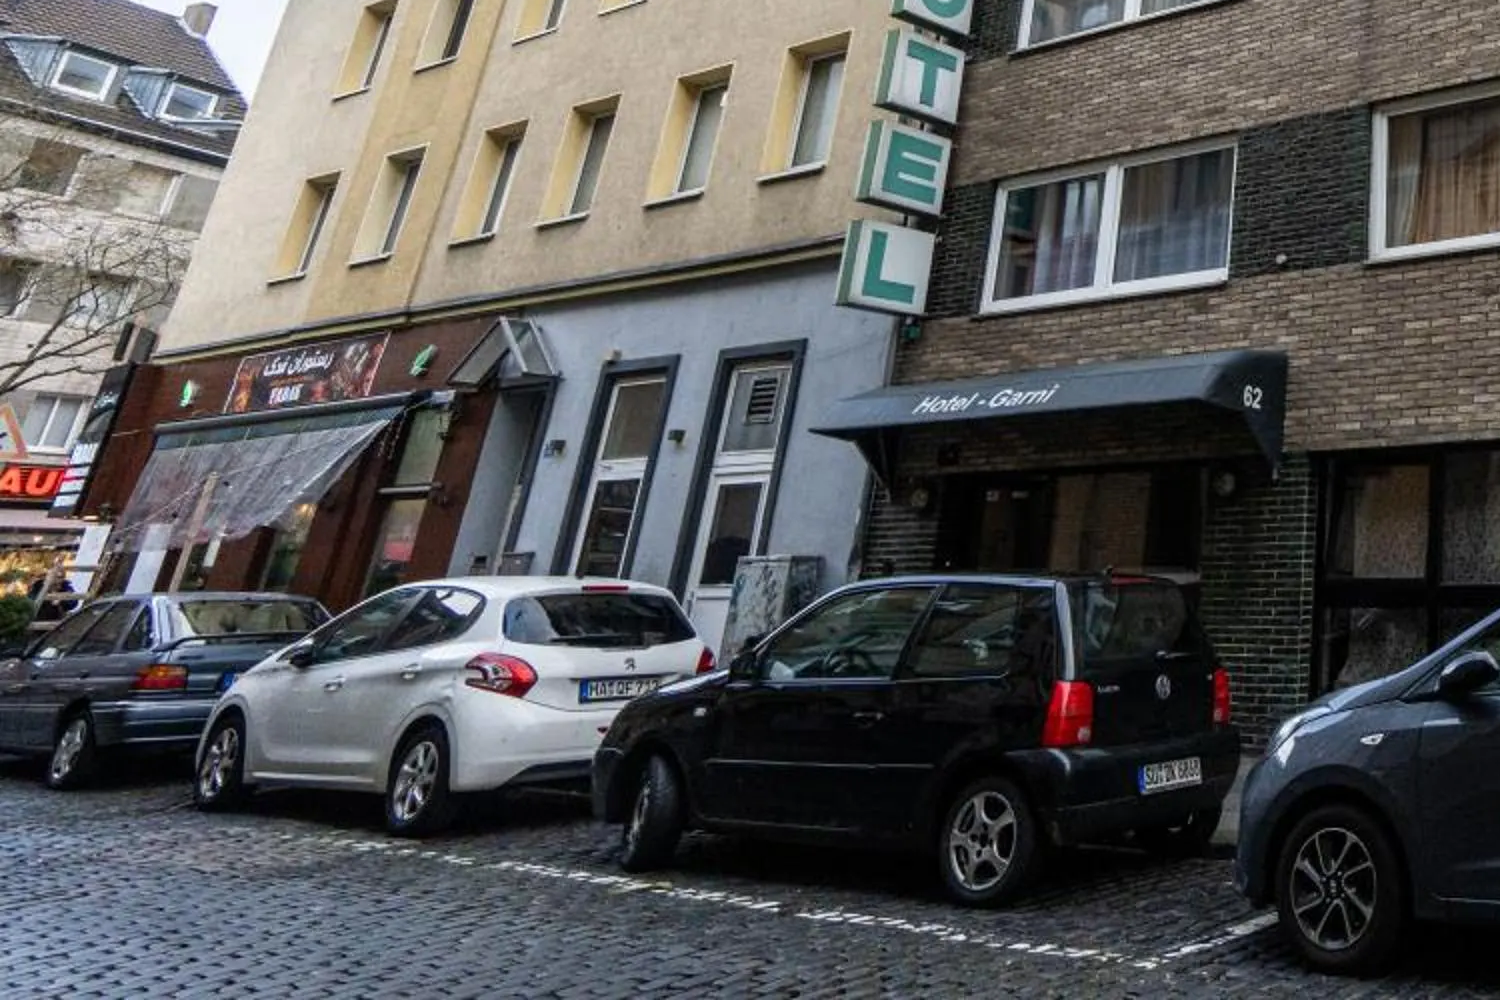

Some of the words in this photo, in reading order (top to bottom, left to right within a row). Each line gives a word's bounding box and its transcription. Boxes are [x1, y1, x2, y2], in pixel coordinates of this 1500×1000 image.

[911, 391, 980, 415] Hotel
[988, 383, 1061, 409] Garni
[1243, 384, 1263, 409] 62
